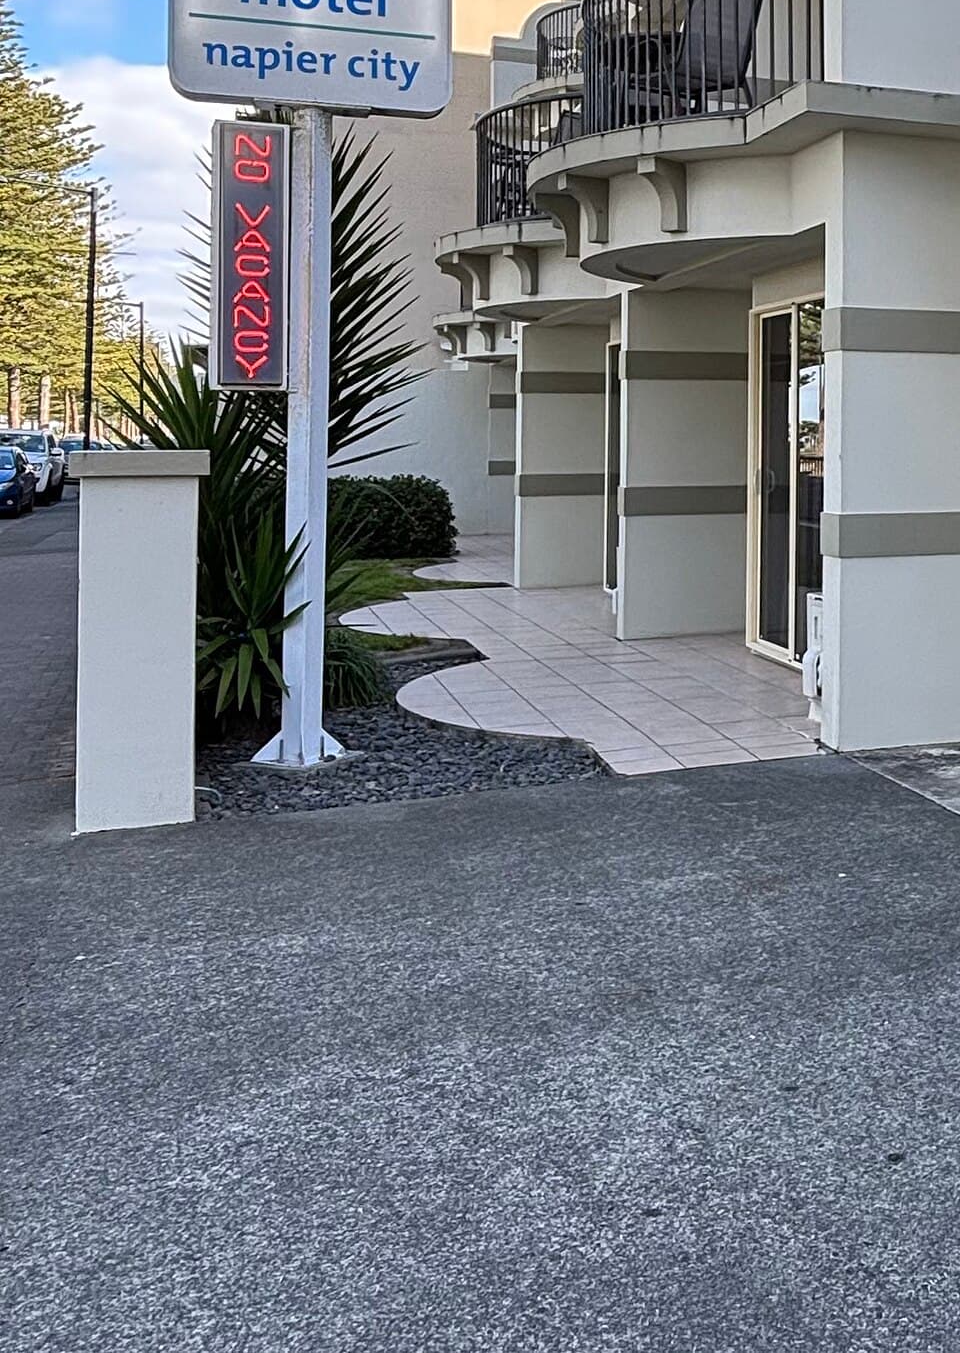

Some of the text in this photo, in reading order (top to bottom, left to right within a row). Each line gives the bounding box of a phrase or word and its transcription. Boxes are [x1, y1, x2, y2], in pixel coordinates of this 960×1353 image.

[202, 41, 421, 91] napier city
[232, 133, 272, 379] NO VACANCY
